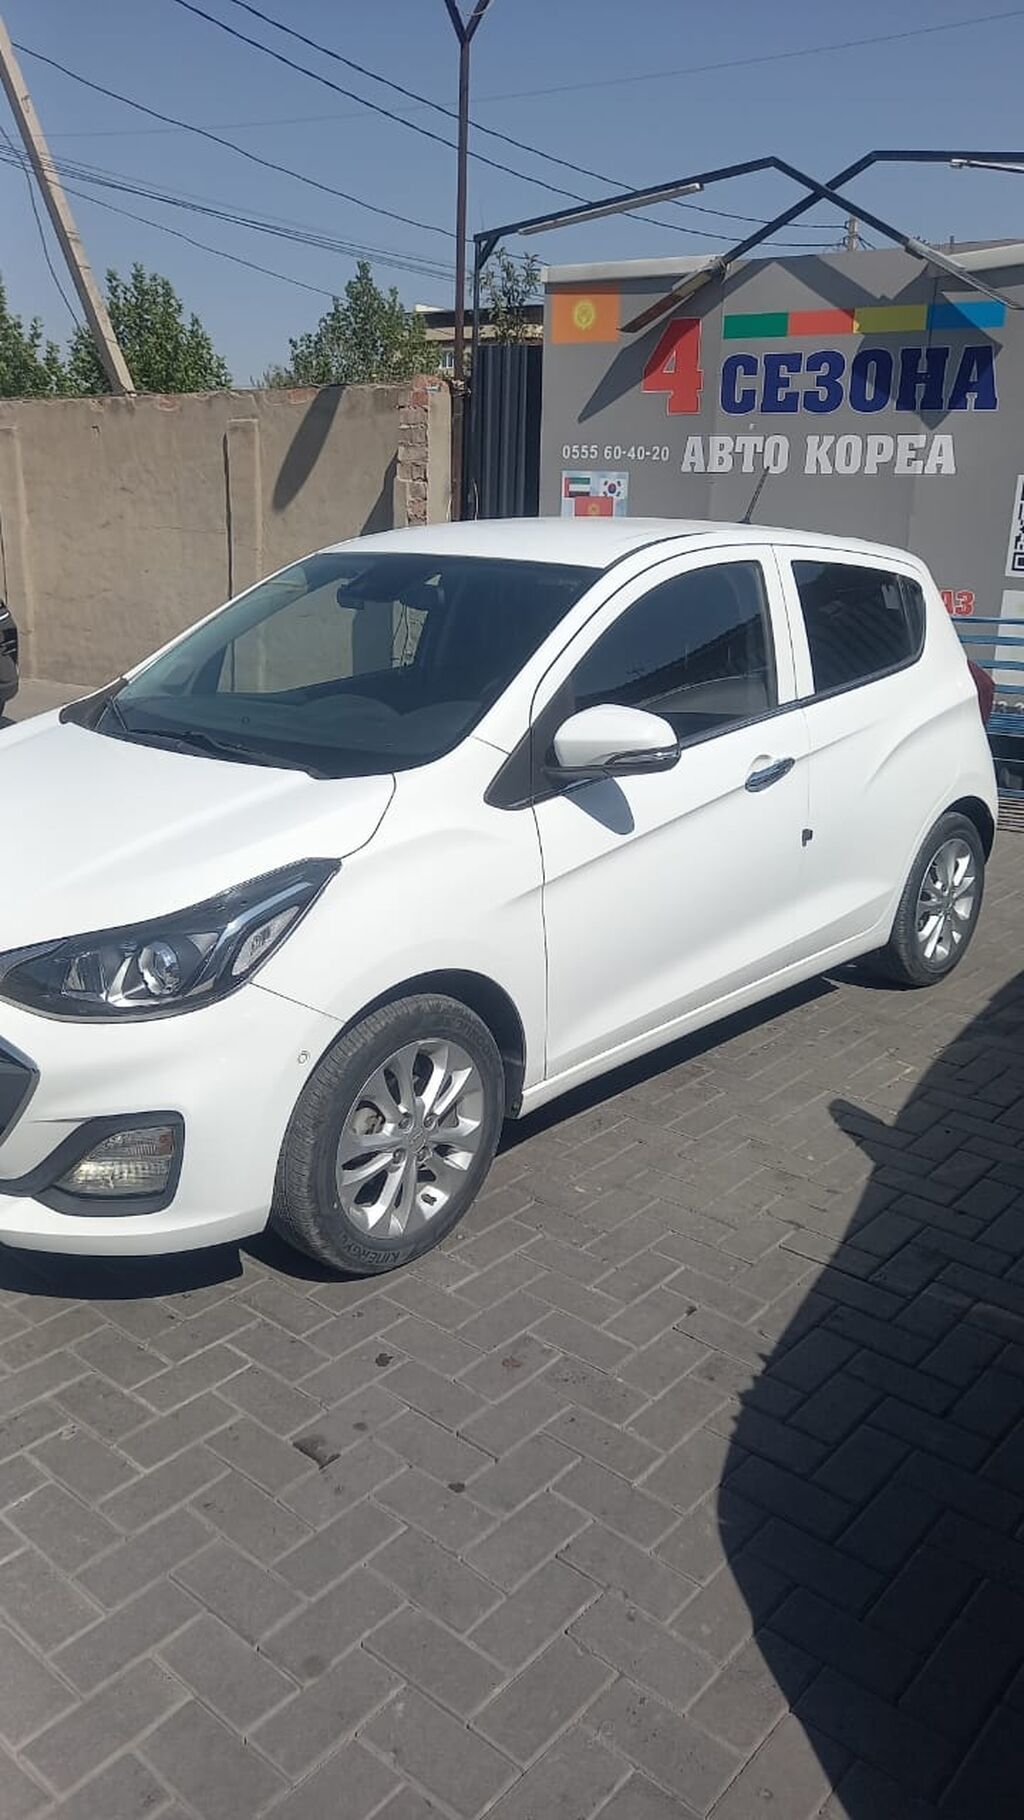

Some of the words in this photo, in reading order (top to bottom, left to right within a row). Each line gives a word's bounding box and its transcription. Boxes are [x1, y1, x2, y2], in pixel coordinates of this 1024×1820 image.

[641, 316, 703, 416] 4
[720, 344, 999, 416] СЕЗОНА
[562, 444, 598, 460] 0555
[603, 445, 670, 461] 60-40-20
[680, 434, 789, 474] АВТО
[803, 433, 957, 475] КОРЕА
